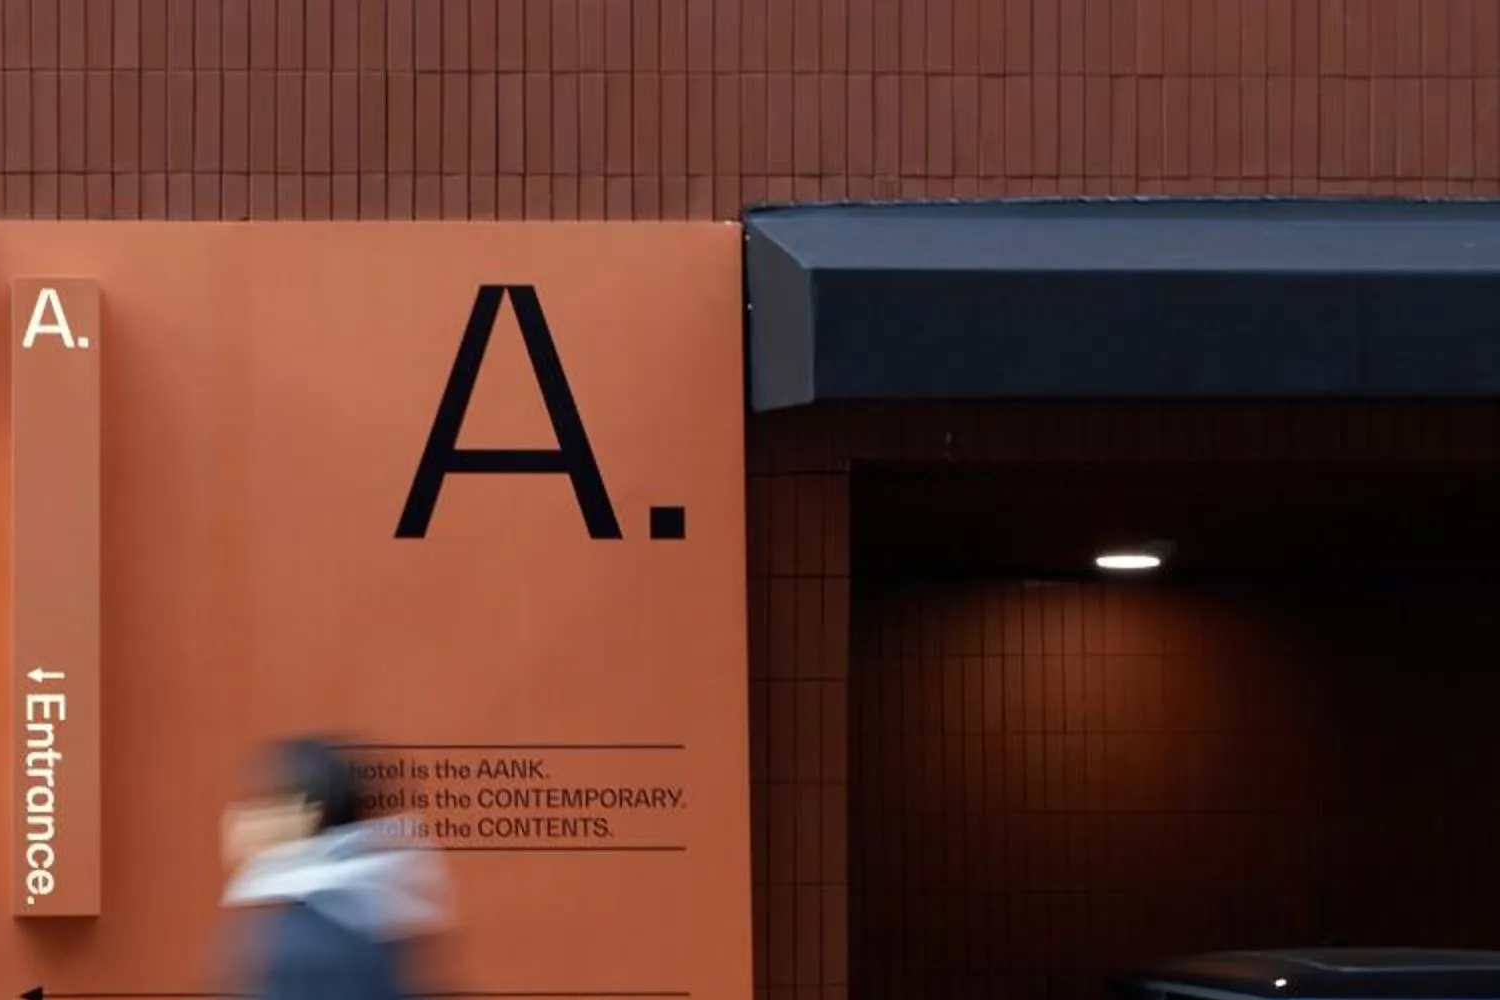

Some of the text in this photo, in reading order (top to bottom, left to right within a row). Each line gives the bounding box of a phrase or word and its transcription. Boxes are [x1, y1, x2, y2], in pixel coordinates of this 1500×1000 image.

[22, 288, 89, 348] A.
[394, 285, 686, 540] A.
[410, 758, 430, 780] is
[435, 758, 471, 780] the
[477, 759, 550, 780] AANK.
[25, 693, 66, 905] Entrance.
[355, 787, 687, 810] otel is the CONTEMPORARY.
[435, 817, 471, 839] the
[477, 817, 615, 839] CONTENTS.
